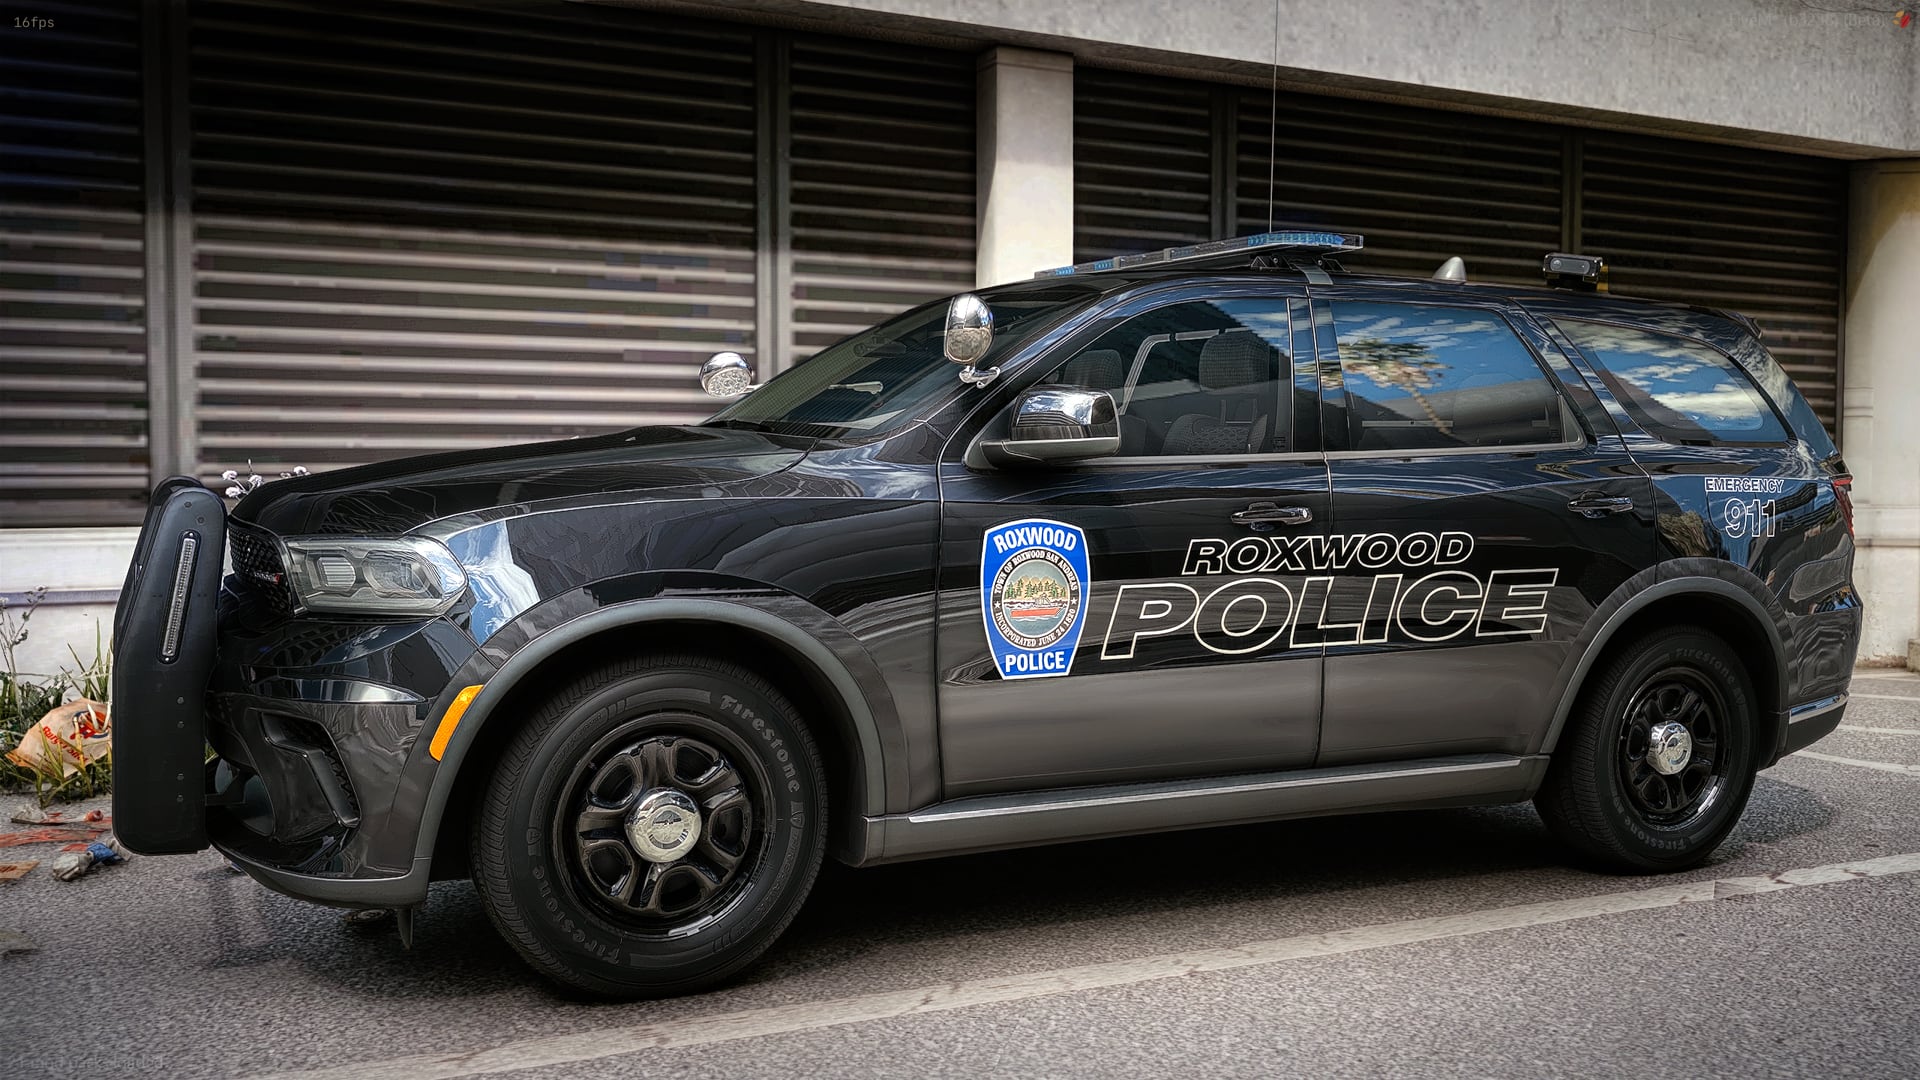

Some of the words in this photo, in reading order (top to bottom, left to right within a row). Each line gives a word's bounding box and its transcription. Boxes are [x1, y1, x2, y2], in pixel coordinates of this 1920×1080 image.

[1704, 477, 1785, 493] EMERGENCY
[1724, 498, 1776, 539] 911
[993, 526, 1077, 554] ROXWOOD
[1181, 531, 1475, 575] ROXWOOD
[994, 573, 1006, 594] TOWN
[1003, 562, 1014, 574] OF
[1012, 552, 1045, 567] ROXWOOD
[1045, 552, 1059, 564] SAN
[1057, 559, 1078, 591] ANDREAS
[994, 612, 1037, 647] INCORPORATED
[1038, 633, 1057, 646] JUNE
[1100, 568, 1559, 661] POLICE
[1005, 651, 1066, 673] POLICE
[1675, 647, 1737, 684] Firestone
[718, 693, 801, 794] Firestone
[1623, 815, 1688, 852] Firestone
[531, 865, 623, 967] Firestone
